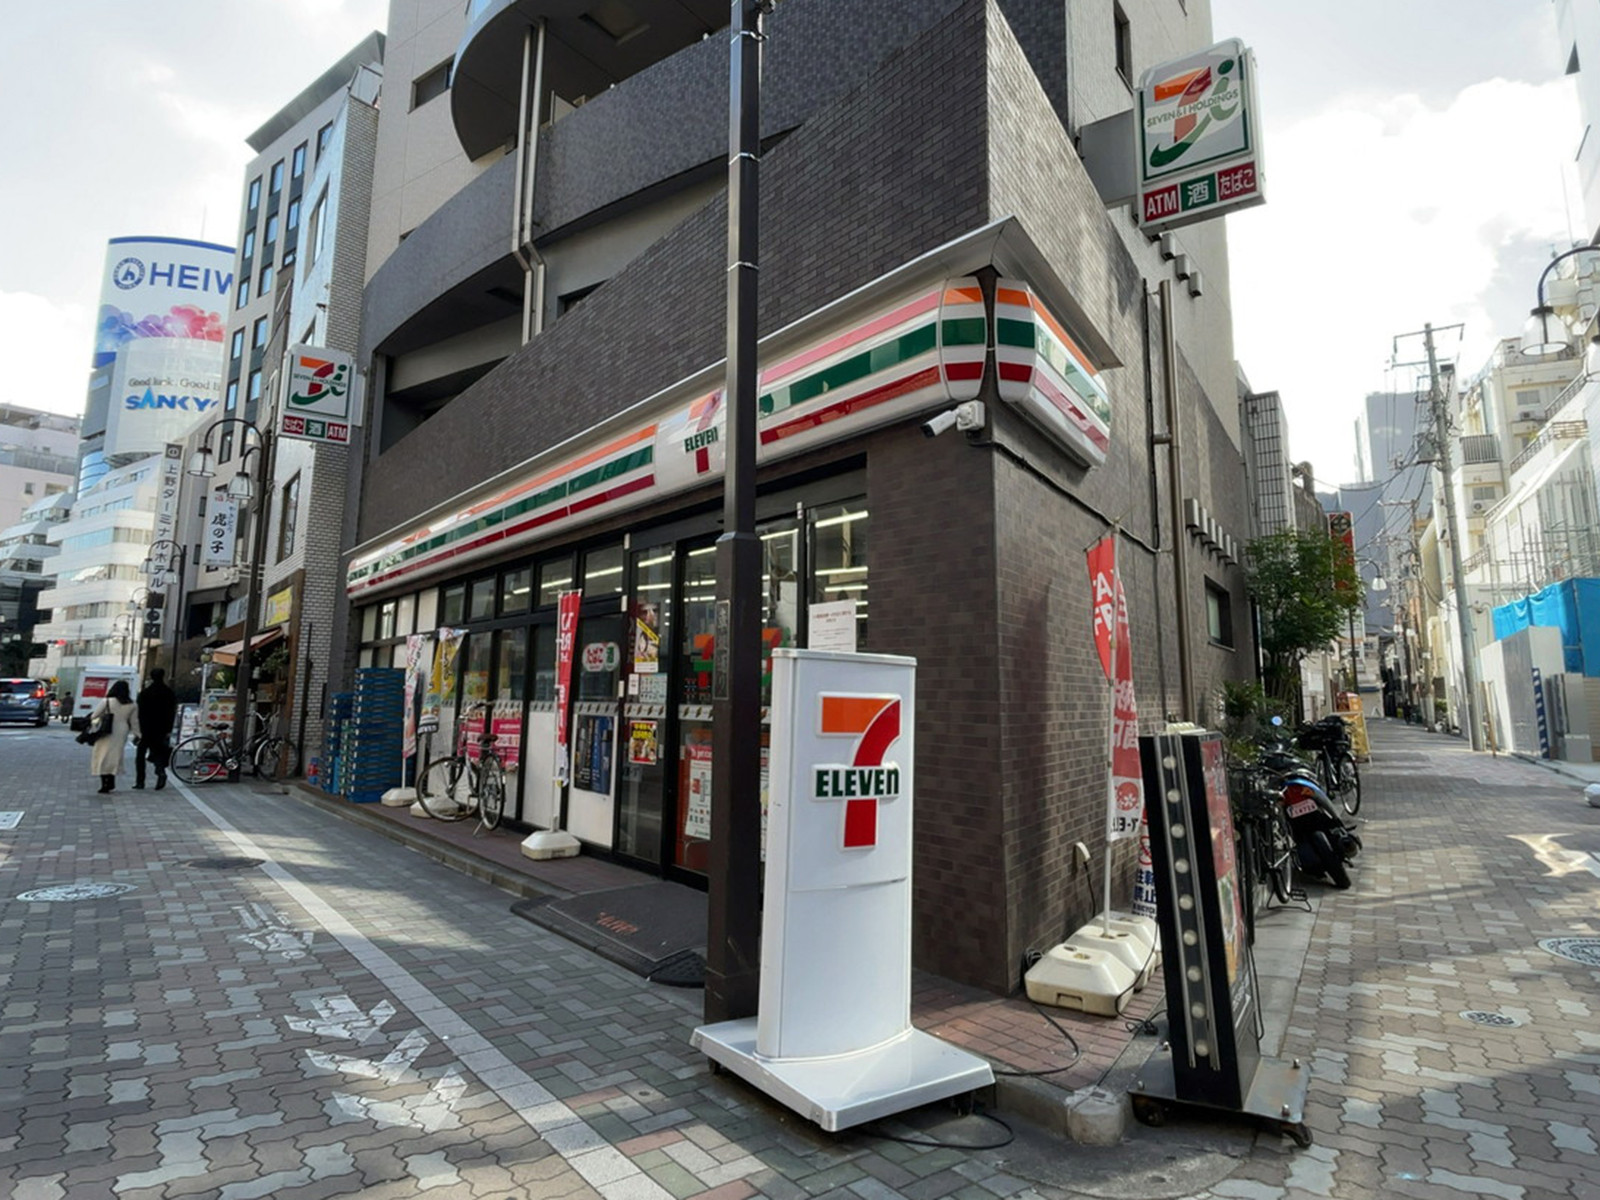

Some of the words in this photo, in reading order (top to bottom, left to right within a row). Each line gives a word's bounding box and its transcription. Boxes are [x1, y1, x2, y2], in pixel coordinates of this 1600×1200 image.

[1188, 88, 1239, 114] HOLDINGS
[1146, 189, 1177, 217] ATM
[1187, 179, 1210, 207] 酒
[1220, 168, 1255, 195] たばこ
[125, 387, 219, 412] SANKY
[327, 424, 347, 440] ATM
[210, 512, 228, 554] 虎の子
